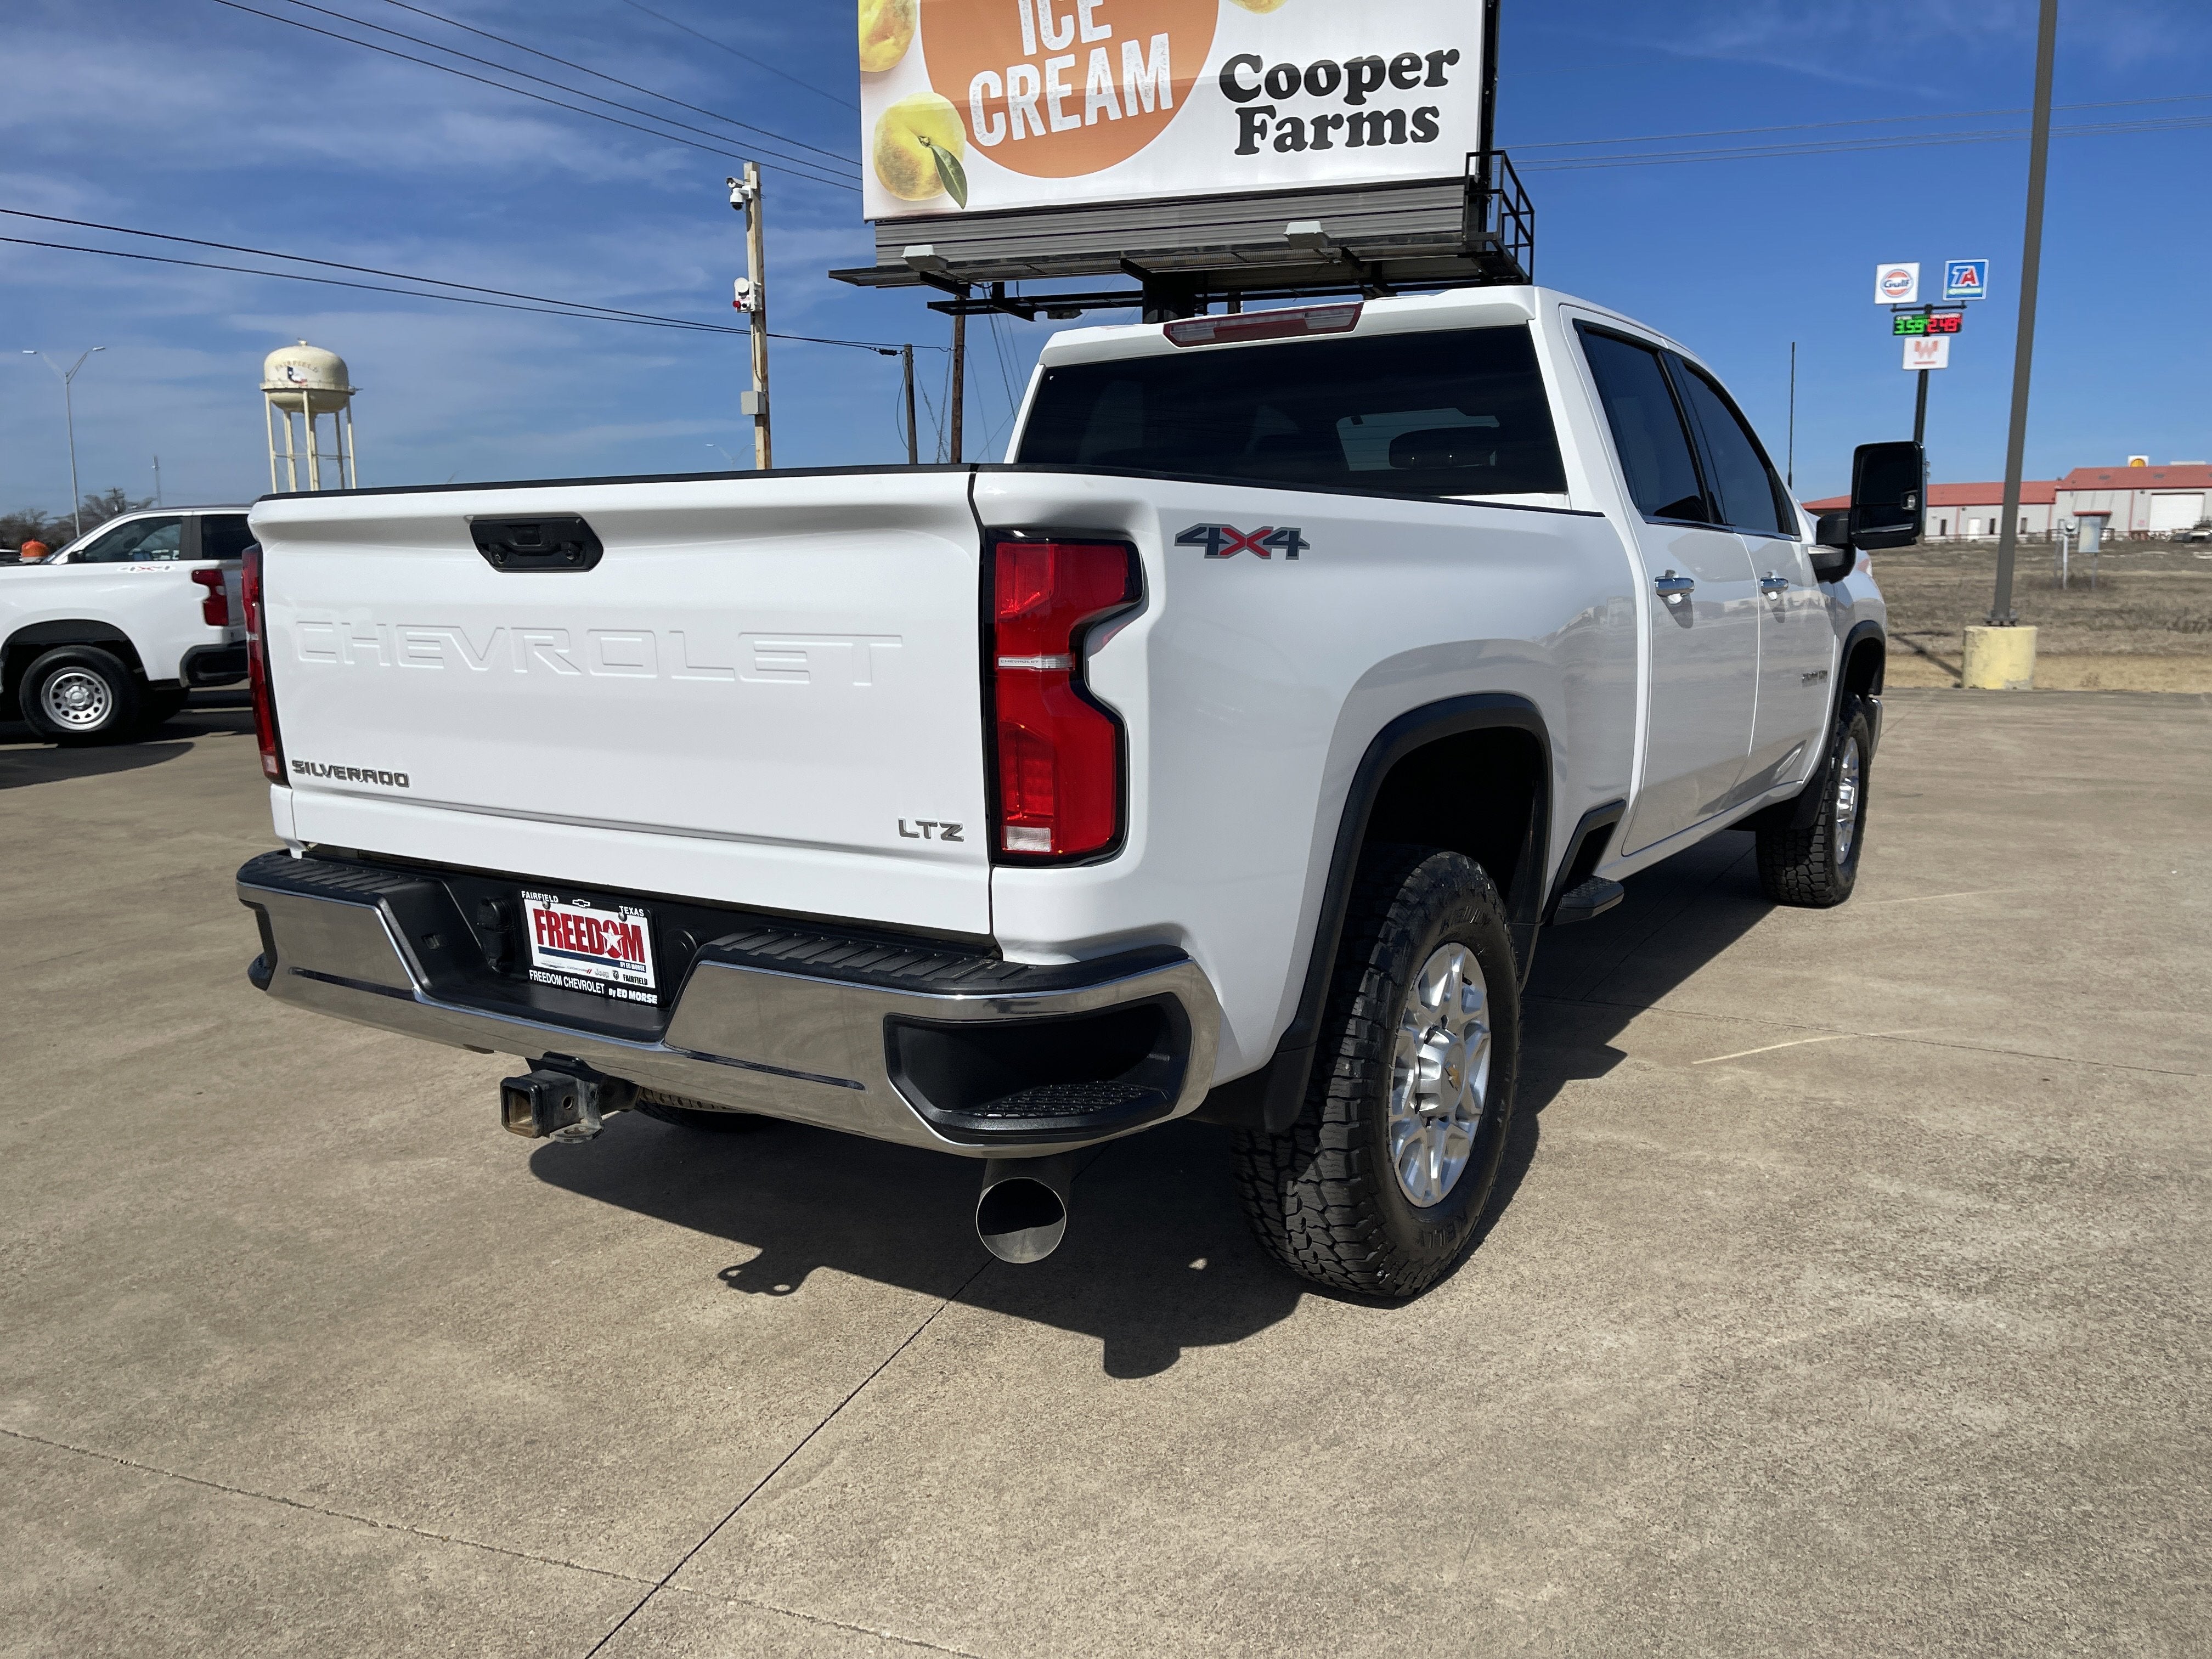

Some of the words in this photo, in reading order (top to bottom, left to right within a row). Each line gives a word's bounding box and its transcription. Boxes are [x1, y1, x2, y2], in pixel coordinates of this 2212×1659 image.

[1018, 0, 1112, 55] ICE
[969, 33, 1173, 146] CREAM
[1219, 48, 1460, 105] Cooper
[1234, 105, 1440, 155] Farms
[1884, 279, 1909, 287] Gulf
[1950, 266, 1980, 287] TA
[296, 620, 903, 686] CHEVROLET
[291, 759, 410, 788] SILVERADO
[898, 816, 964, 842] LTZ
[521, 890, 558, 904] FAIRFIELD
[619, 905, 644, 917] TEXAS
[533, 908, 646, 963] FREEDOM
[595, 968, 610, 979] Jeep
[623, 974, 648, 985] FAIRFIELD
[631, 963, 645, 972] MORSE
[529, 969, 562, 986] FREEDOM
[563, 977, 605, 994] CHEVROLET
[608, 988, 616, 997] By
[617, 988, 628, 998] ED
[628, 990, 657, 1004] MORSE
